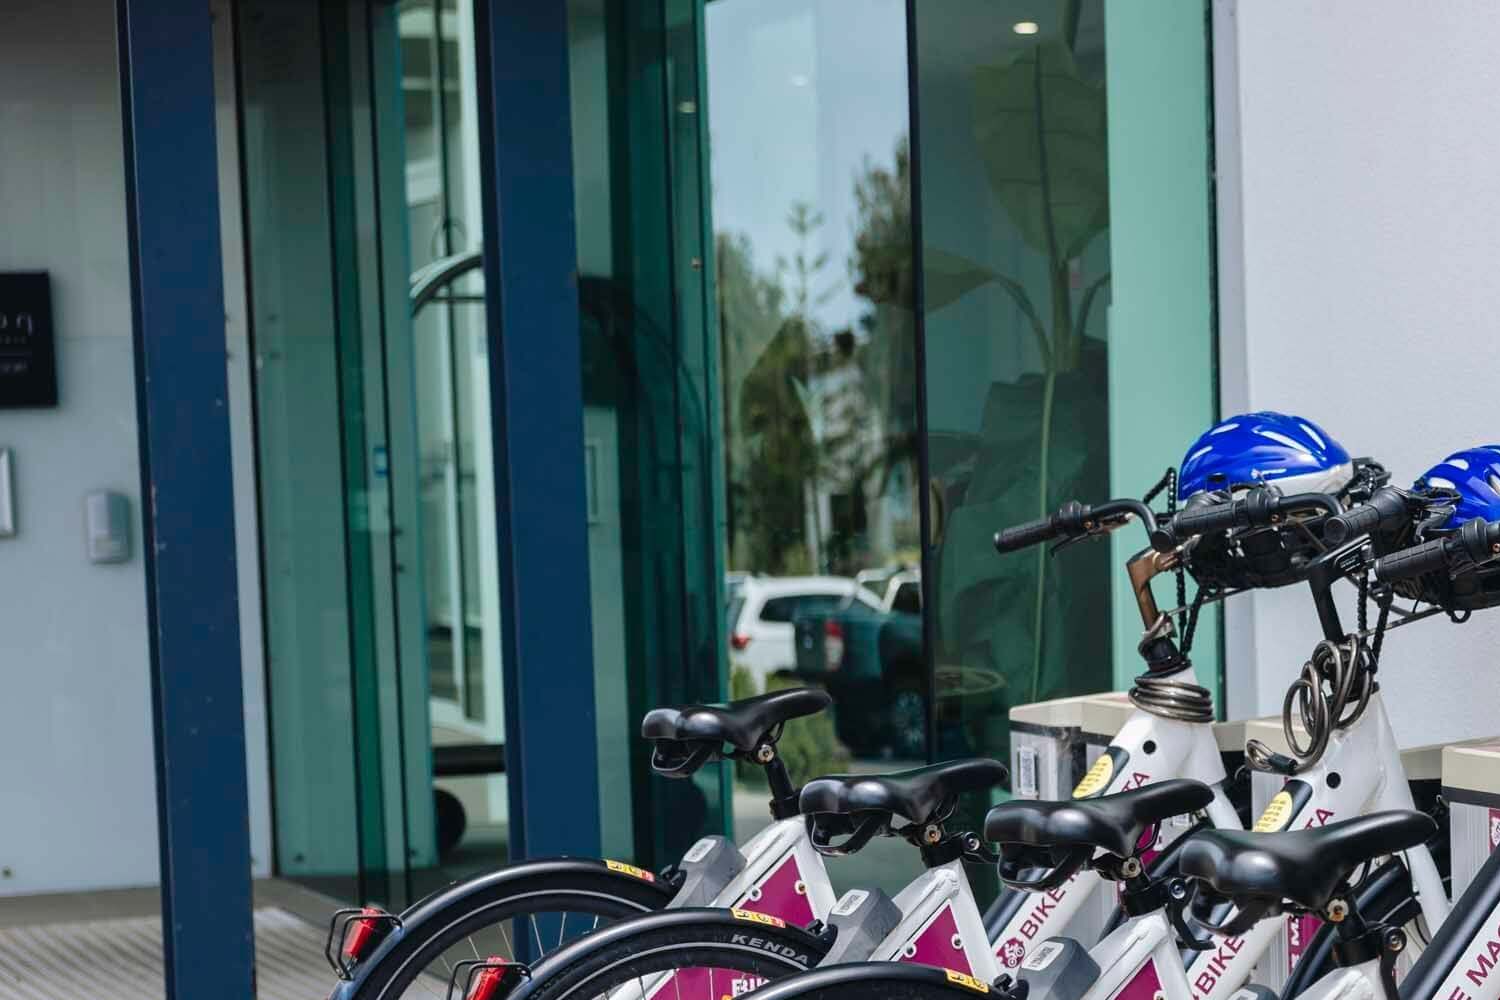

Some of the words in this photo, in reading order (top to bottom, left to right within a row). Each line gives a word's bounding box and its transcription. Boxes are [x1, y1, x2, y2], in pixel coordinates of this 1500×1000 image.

[1019, 886, 1066, 940] BIKE
[731, 934, 809, 965] KENDA
[1194, 935, 1245, 995] BIKE
